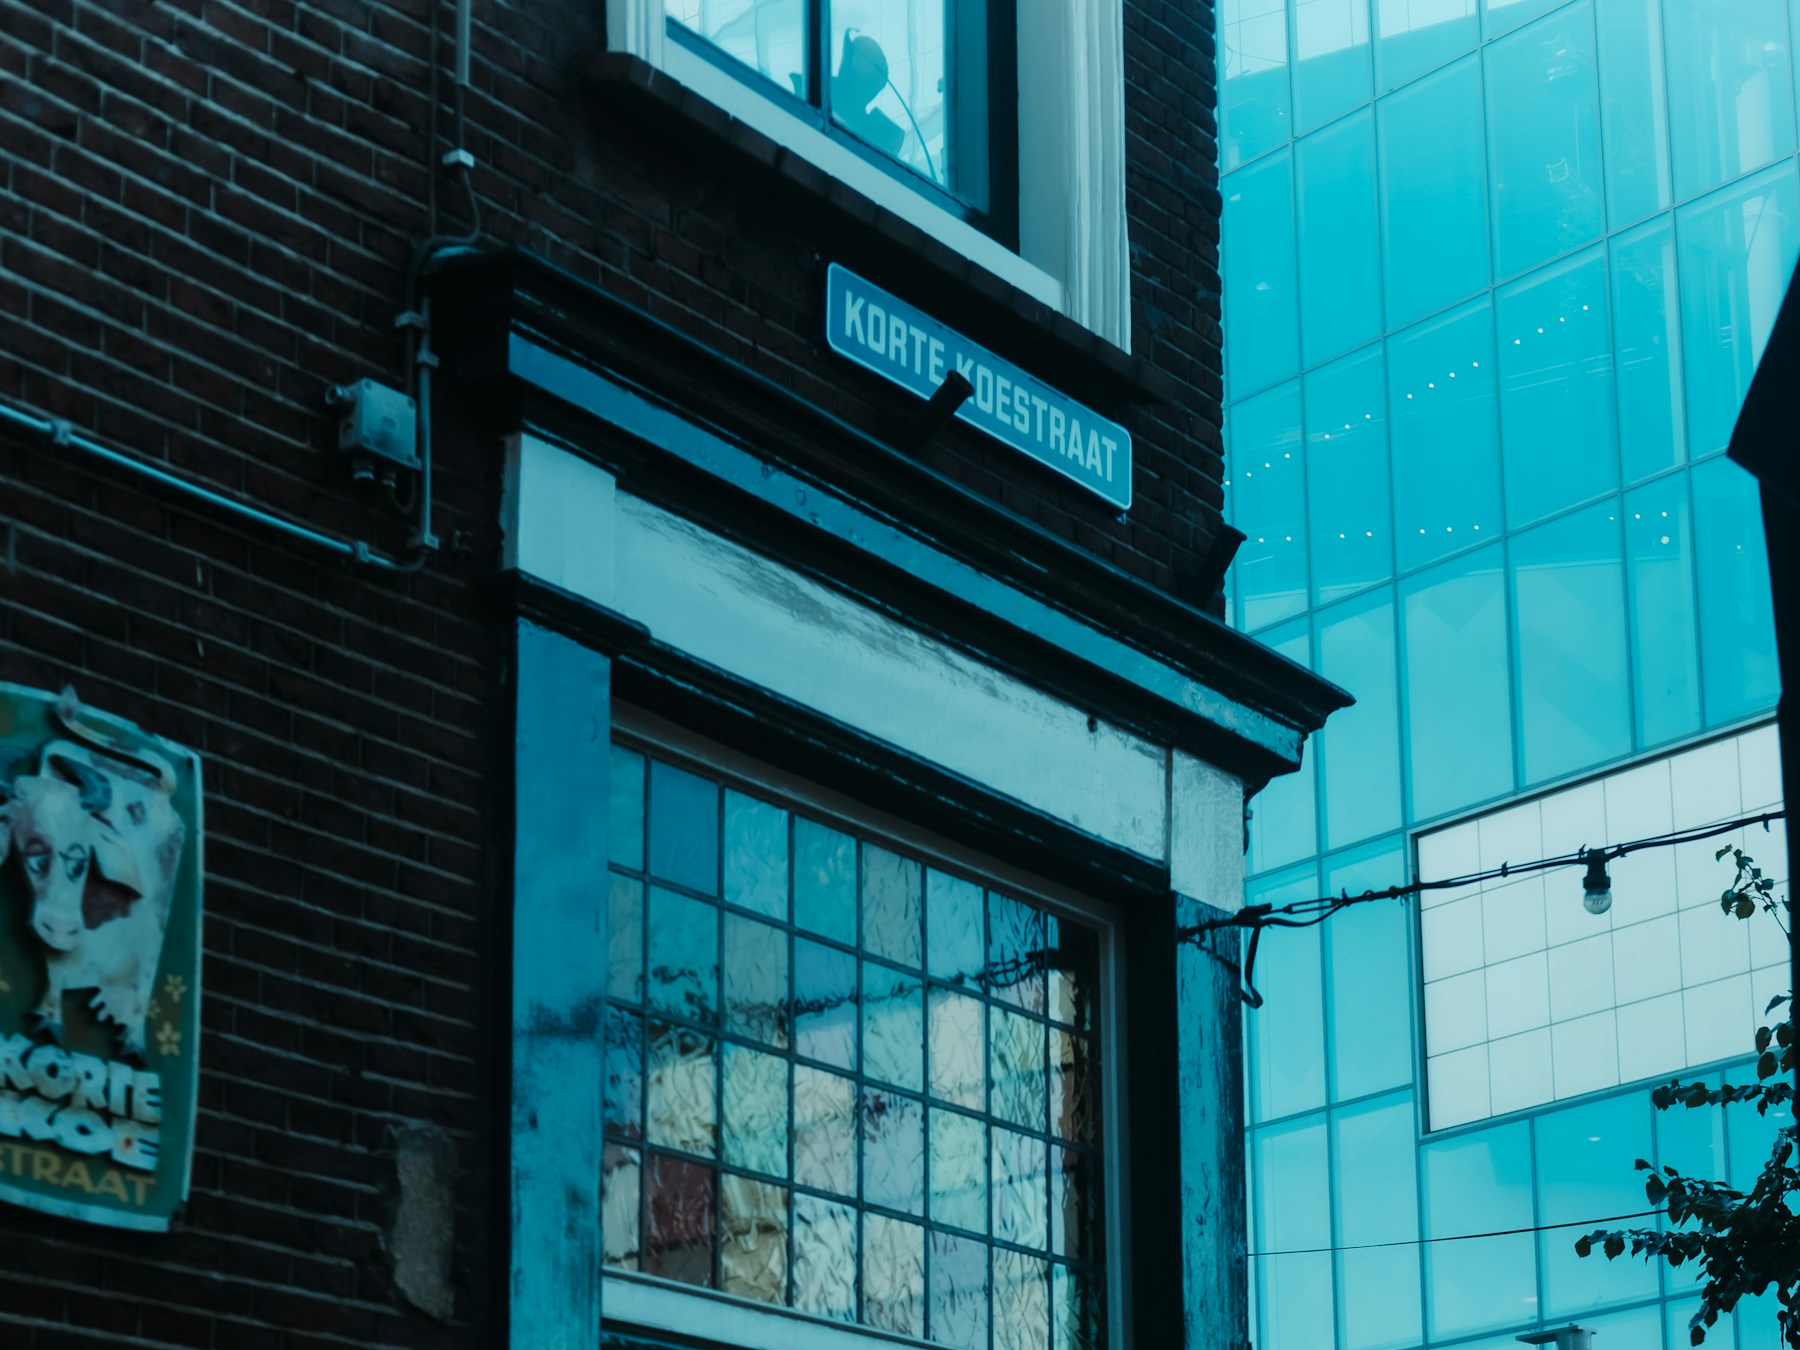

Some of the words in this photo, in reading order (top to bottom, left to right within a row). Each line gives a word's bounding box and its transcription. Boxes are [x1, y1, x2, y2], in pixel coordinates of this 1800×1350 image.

[844, 288, 945, 387] KORTE
[956, 351, 1118, 483] KOESTRAAT
[0, 1142, 156, 1207] TRAAT
